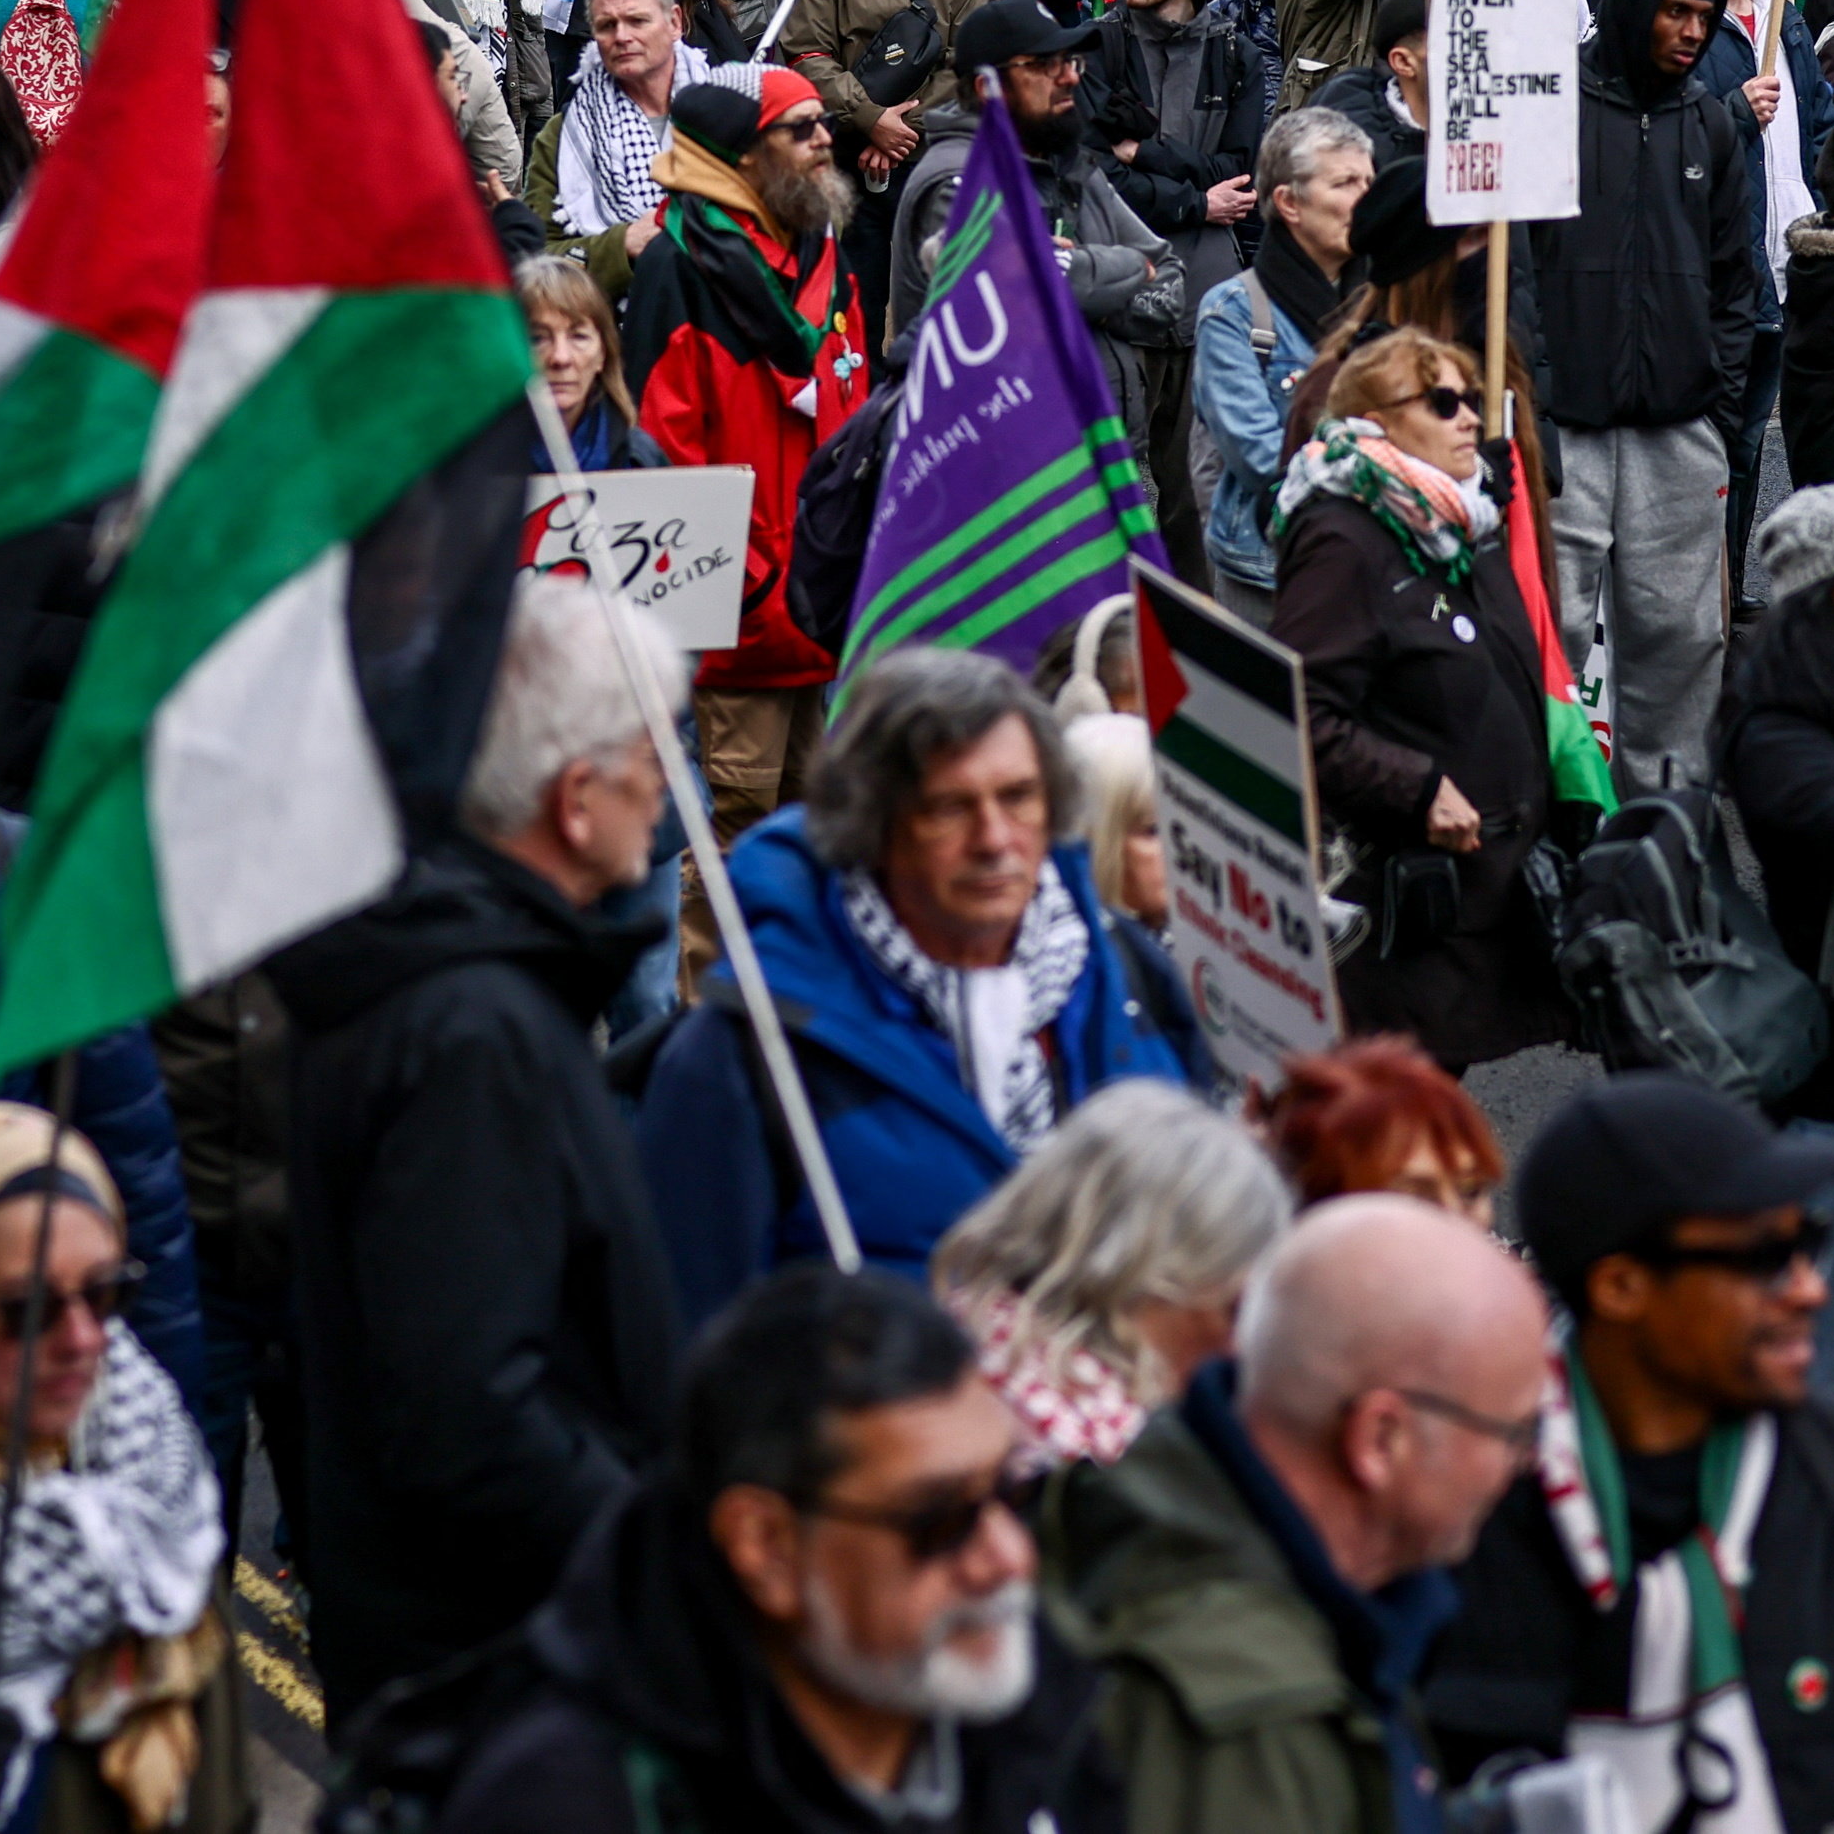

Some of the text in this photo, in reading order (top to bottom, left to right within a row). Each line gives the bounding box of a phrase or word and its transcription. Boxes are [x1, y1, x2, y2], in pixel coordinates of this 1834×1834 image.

[1449, 9, 1474, 28] TO
[1449, 30, 1488, 50] THE
[1447, 53, 1489, 74] SEA
[1447, 74, 1561, 96] PALESTINE
[1449, 98, 1500, 118] WILL
[1445, 120, 1471, 141] BE
